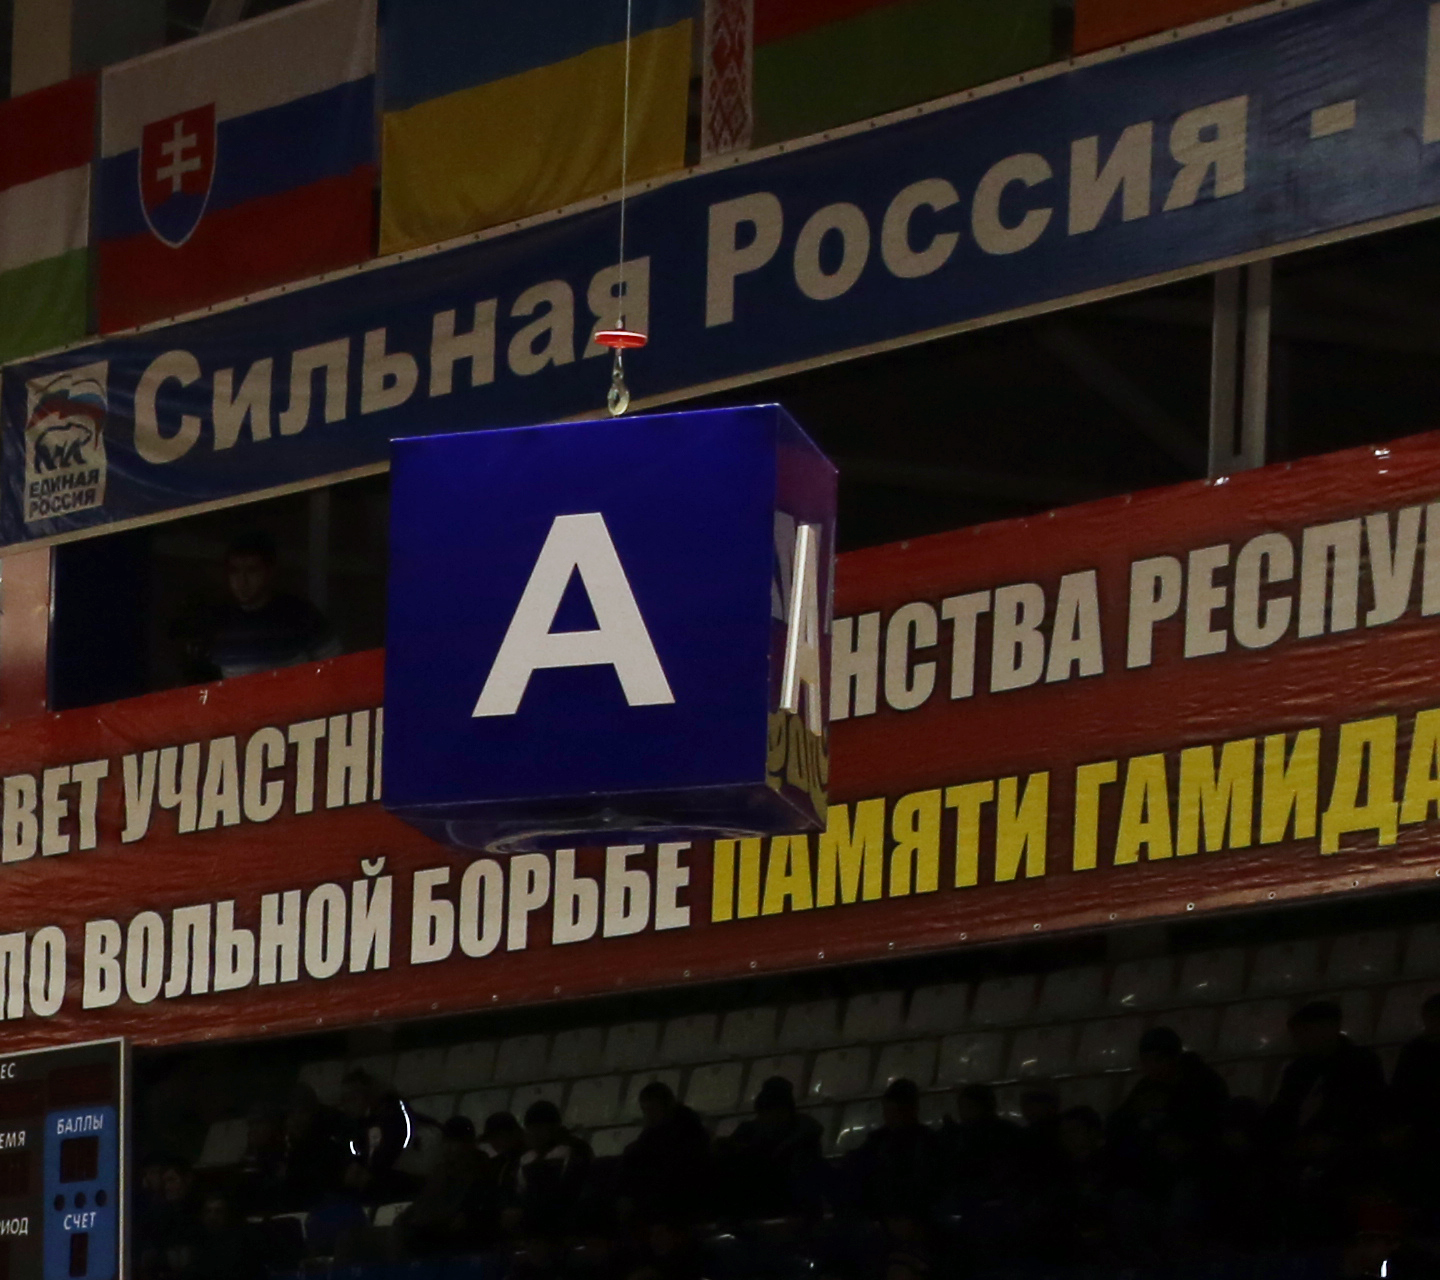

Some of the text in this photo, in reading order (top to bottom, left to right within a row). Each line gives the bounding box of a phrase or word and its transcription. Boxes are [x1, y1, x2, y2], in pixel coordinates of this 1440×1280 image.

[133, 256, 650, 466] Сильная
[705, 94, 1249, 328] Россия
[30, 469, 99, 499] ЕДИНАЯ
[30, 488, 96, 518] РОССИЯ
[471, 512, 676, 718] A
[82, 857, 394, 1012] ВОЛЬНОЙ
[409, 841, 691, 967] БОРЬБЕ
[711, 771, 1050, 924] ПАМЯТИ
[56, 1113, 104, 1135] БАЛЛЫ
[63, 1211, 97, 1231] СЧЕТ
